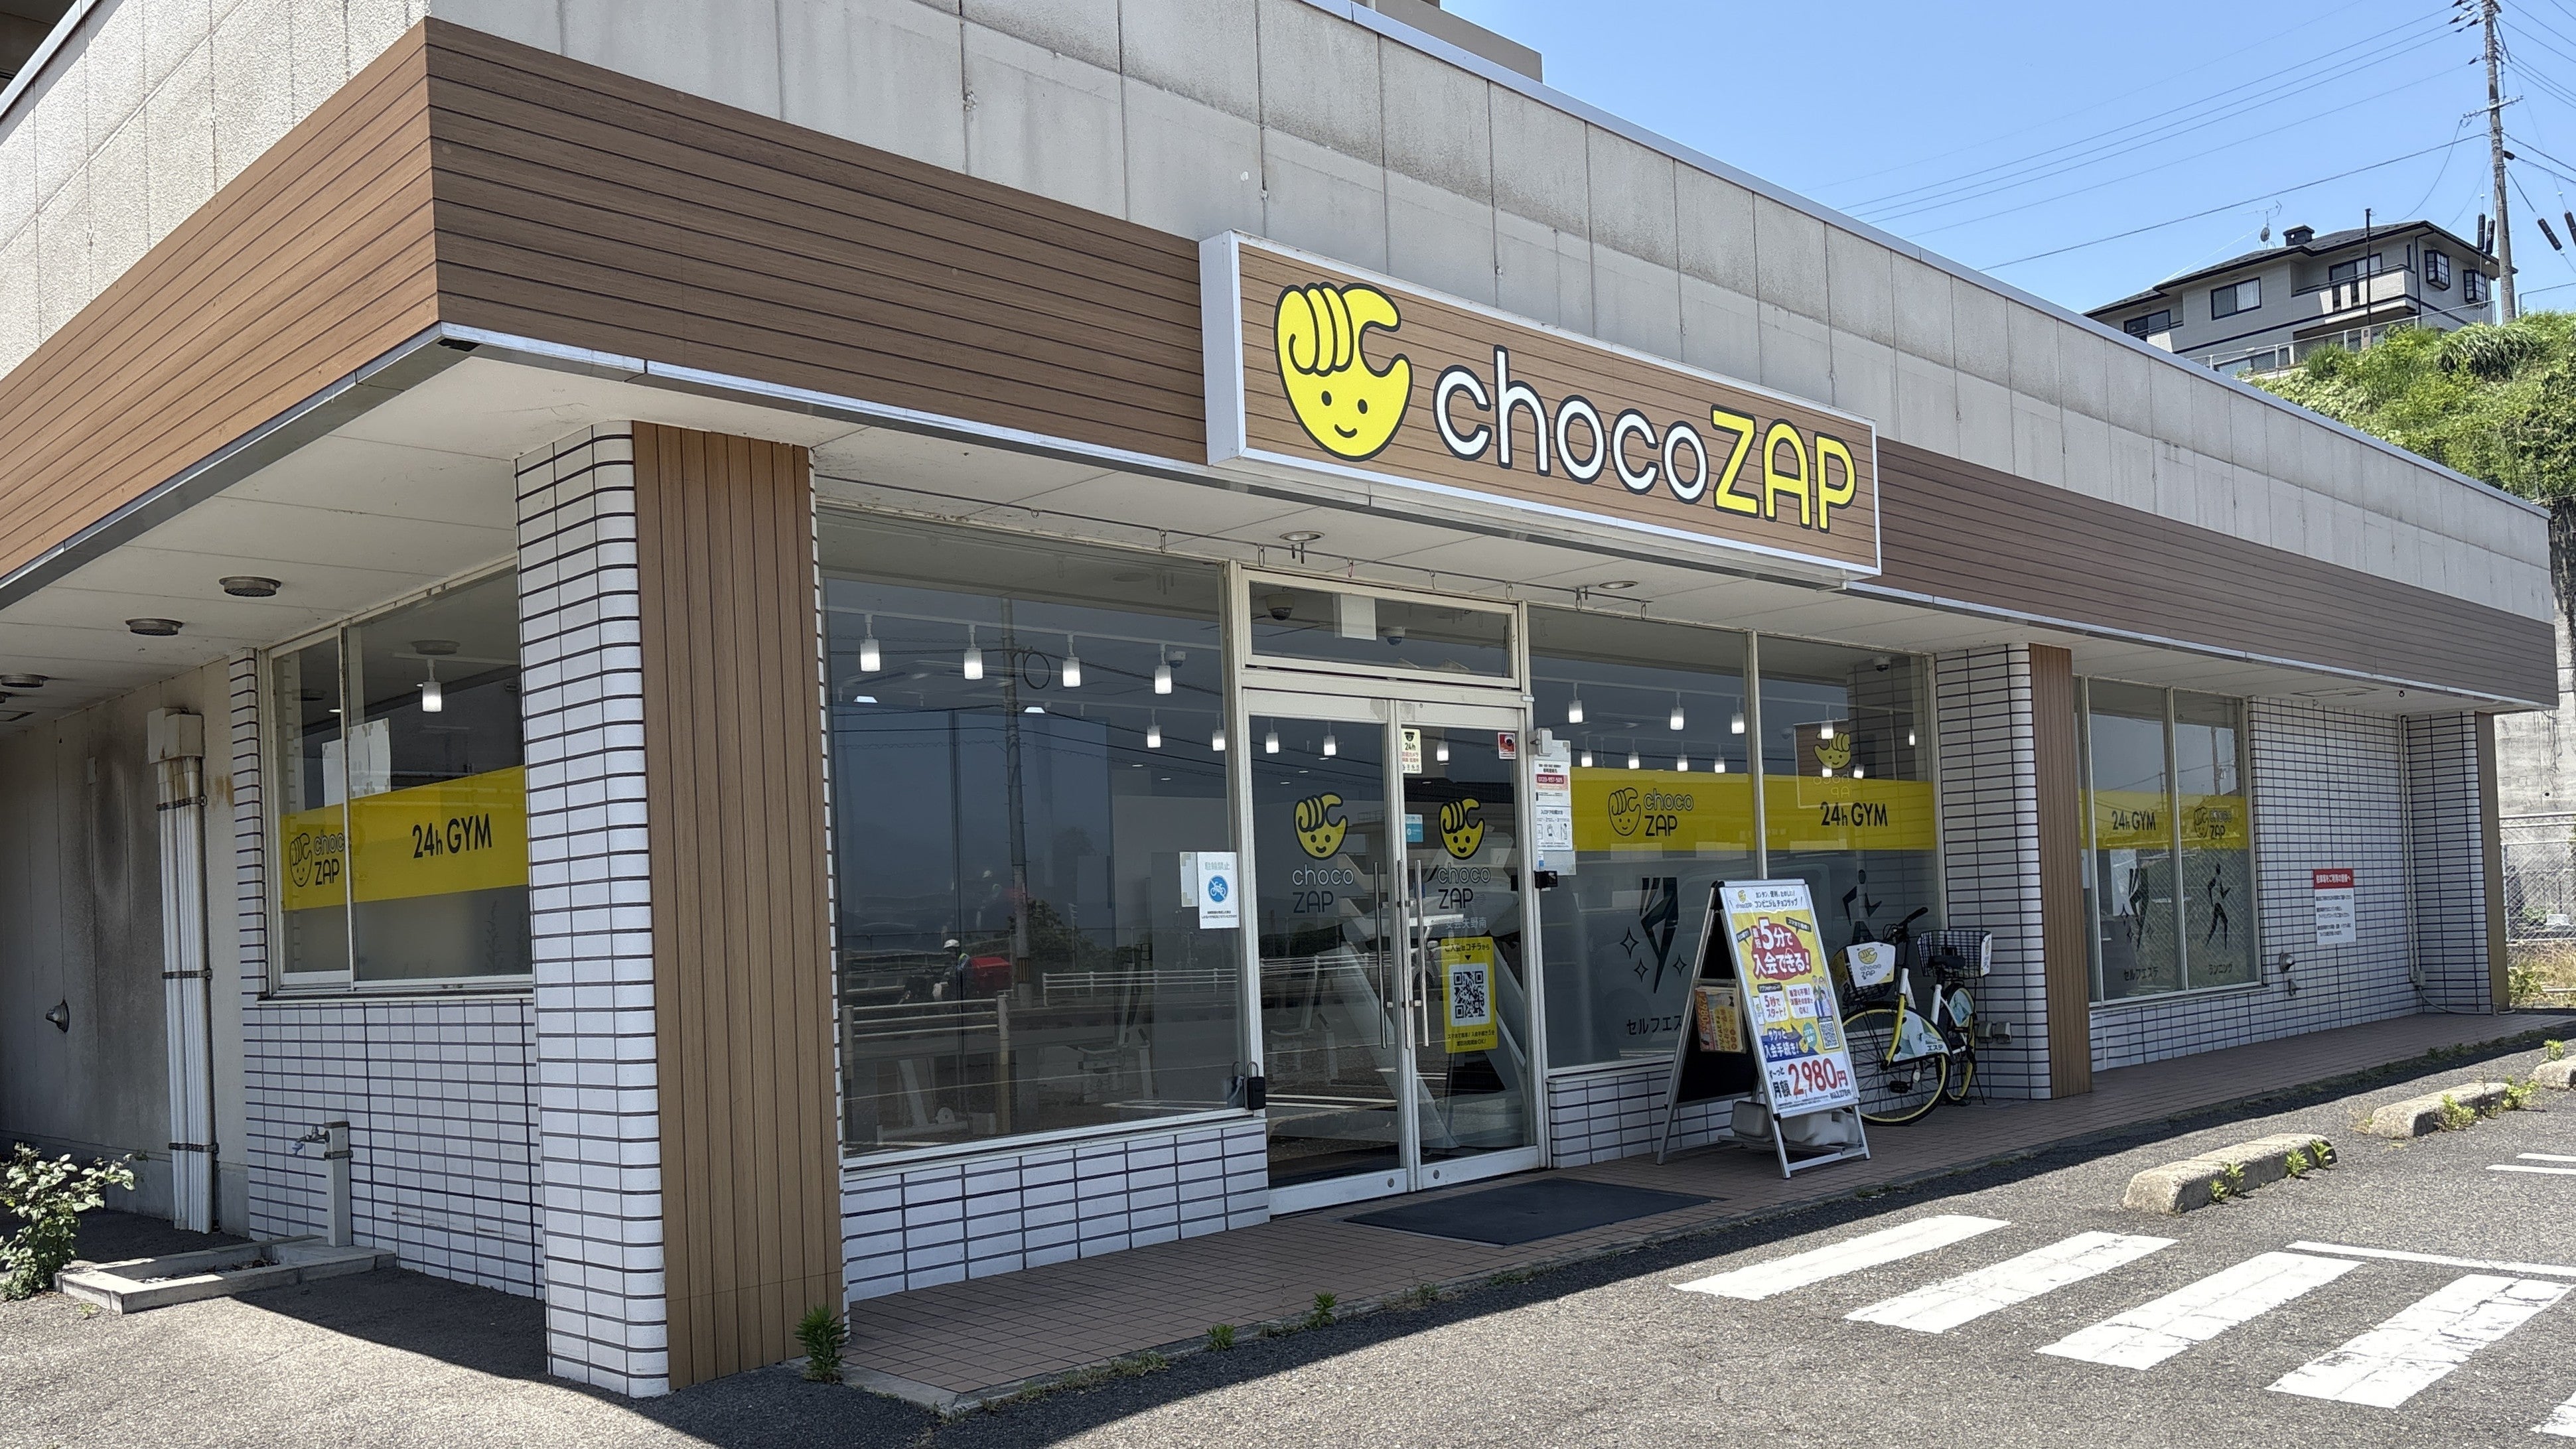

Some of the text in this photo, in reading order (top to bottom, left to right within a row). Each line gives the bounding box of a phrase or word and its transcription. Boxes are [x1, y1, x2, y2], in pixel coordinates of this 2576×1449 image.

[1433, 344, 1857, 533] chocoZAP
[1644, 788, 1693, 811] choco
[1645, 814, 1678, 837] ZAP
[1820, 801, 1888, 827] 24h GYM
[2111, 810, 2157, 831] 24h GYM
[313, 829, 345, 856] choc
[412, 813, 492, 859] 24h GYM
[2210, 825, 2226, 840] ZAP
[315, 859, 340, 886] ZAP
[1291, 862, 1354, 886] choco
[1437, 862, 1491, 884] choco
[1292, 890, 1334, 914] ZAP
[1438, 888, 1474, 910] ZAP
[1753, 951, 1810, 976] 入会できる!
[2124, 966, 2159, 981] セルフエステ
[1626, 1015, 1682, 1035] セルフエス
[1772, 1080, 1792, 1099] 月額
